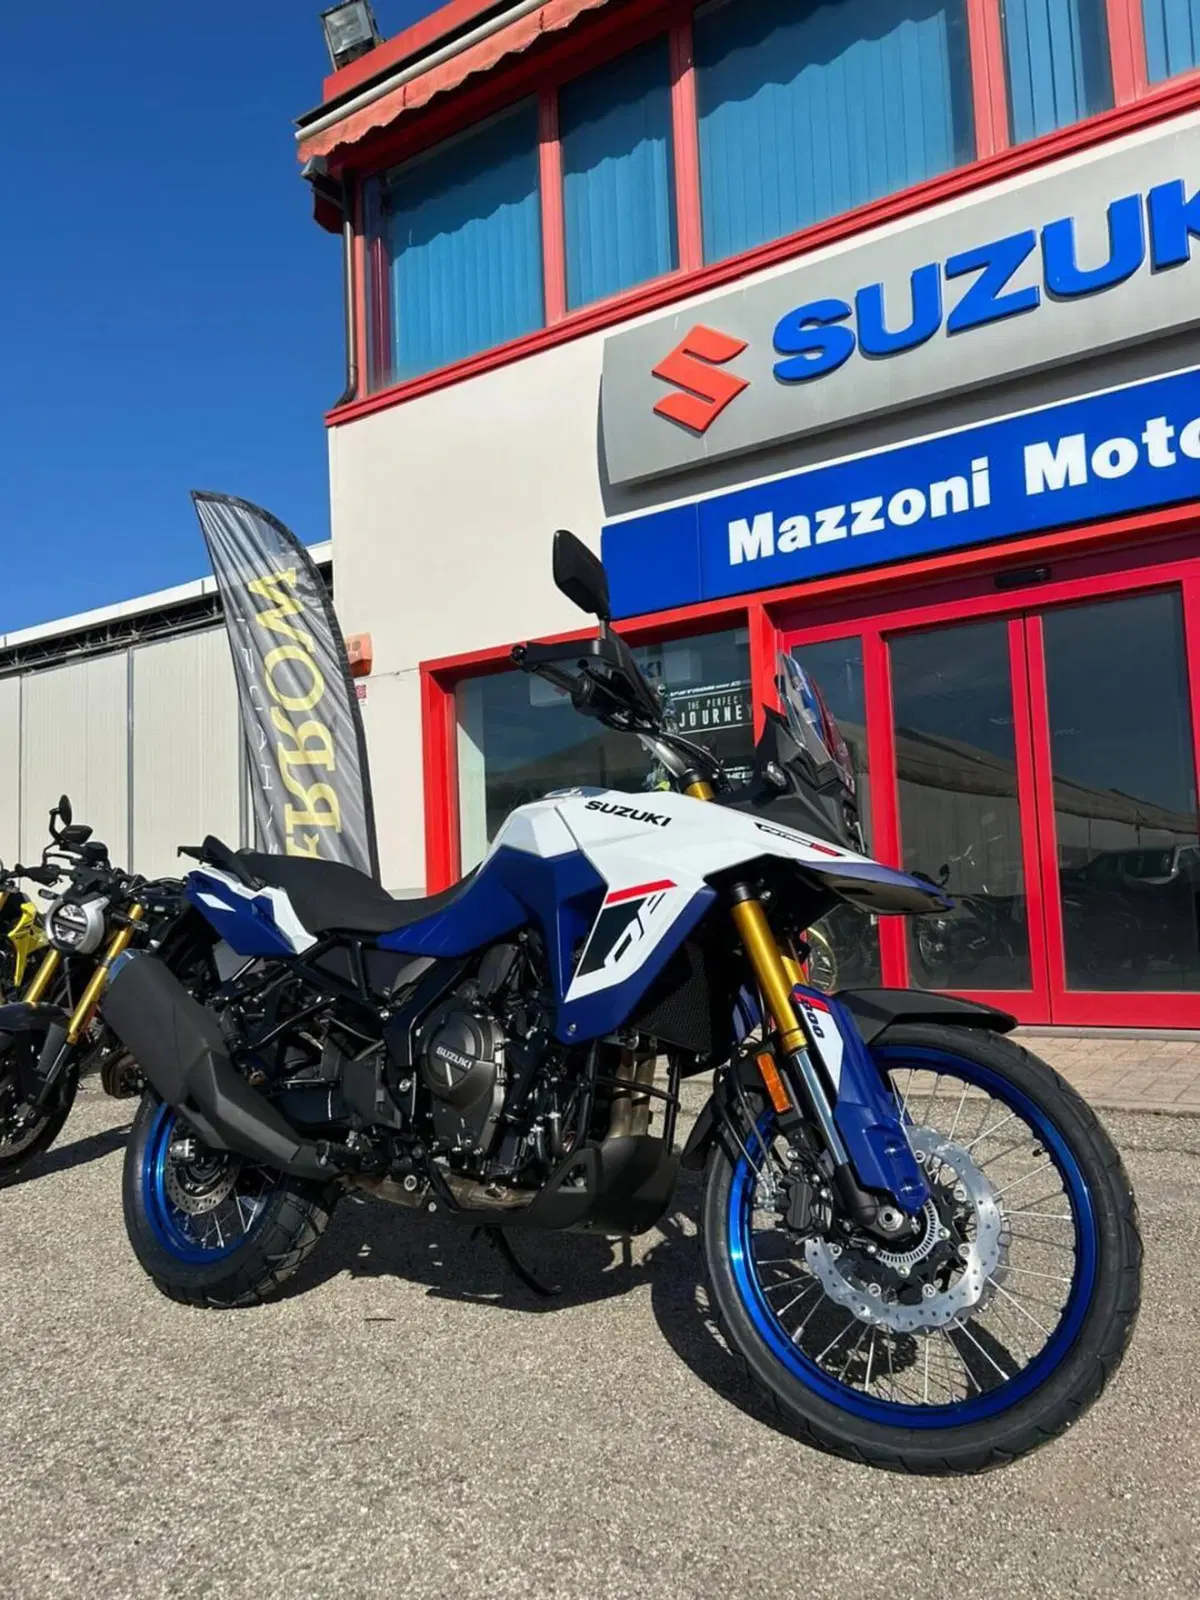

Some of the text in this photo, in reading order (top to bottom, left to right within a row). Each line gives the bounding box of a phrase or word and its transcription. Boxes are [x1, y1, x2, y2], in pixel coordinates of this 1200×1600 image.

[728, 458, 990, 565] Mazzoni
[584, 800, 672, 827] SUZUKI
[436, 1046, 473, 1070] SUZUKI
